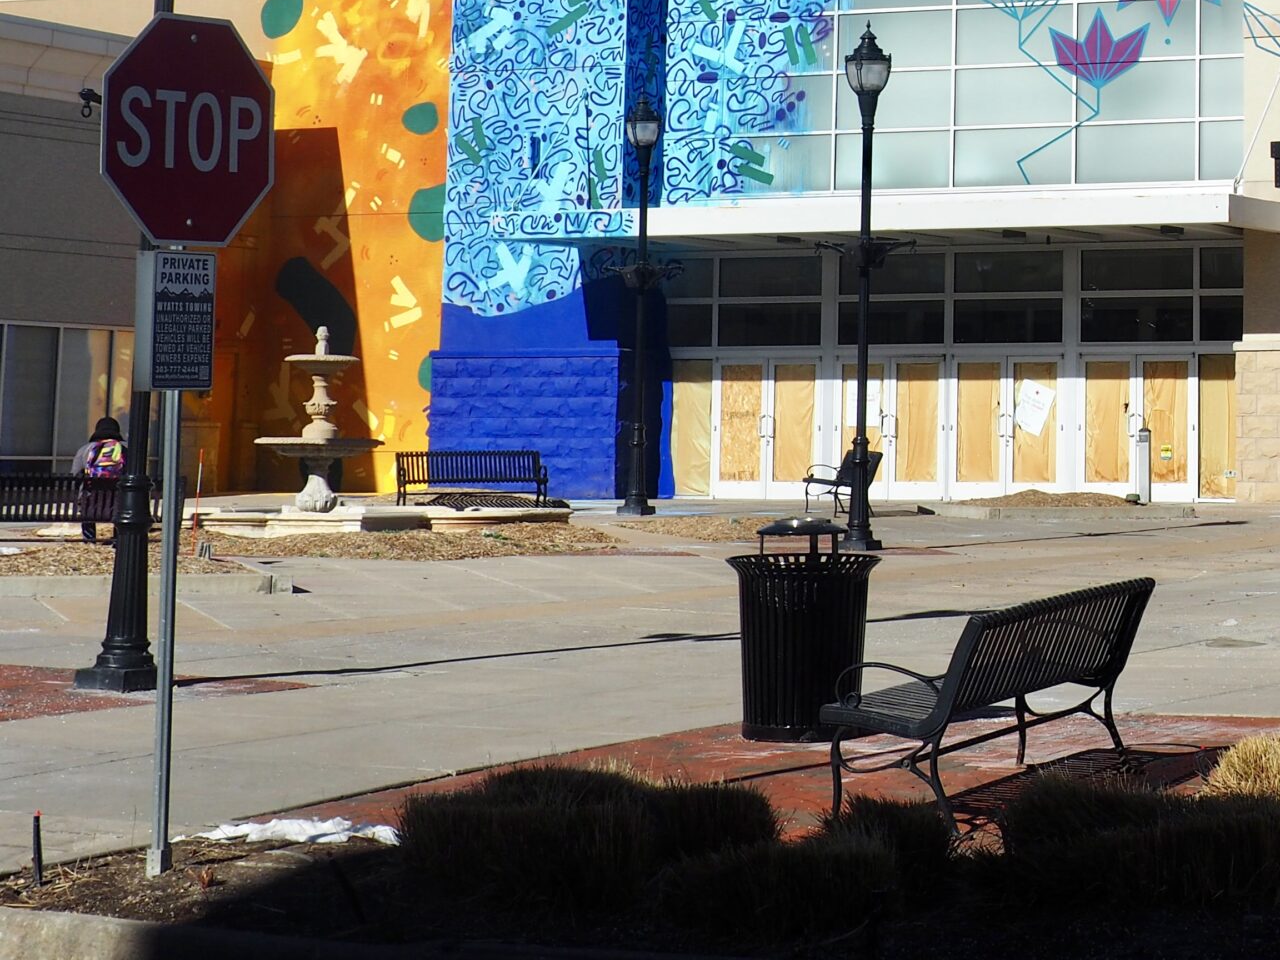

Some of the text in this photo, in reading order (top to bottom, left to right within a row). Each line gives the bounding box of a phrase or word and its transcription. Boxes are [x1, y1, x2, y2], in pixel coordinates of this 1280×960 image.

[115, 85, 262, 173] STOP
[162, 257, 209, 270] PRIVATE
[160, 271, 210, 285] PARKING
[157, 301, 212, 312] WYATTS TOWING
[156, 313, 211, 324] UNAUTHORIZED OR
[156, 323, 211, 334] ILLEGALLY PARKED
[156, 333, 210, 343] VEHICLES WILL BE
[155, 343, 211, 353] TOWED AT VEHICLE
[155, 353, 209, 363] OWNERS EXPENSE
